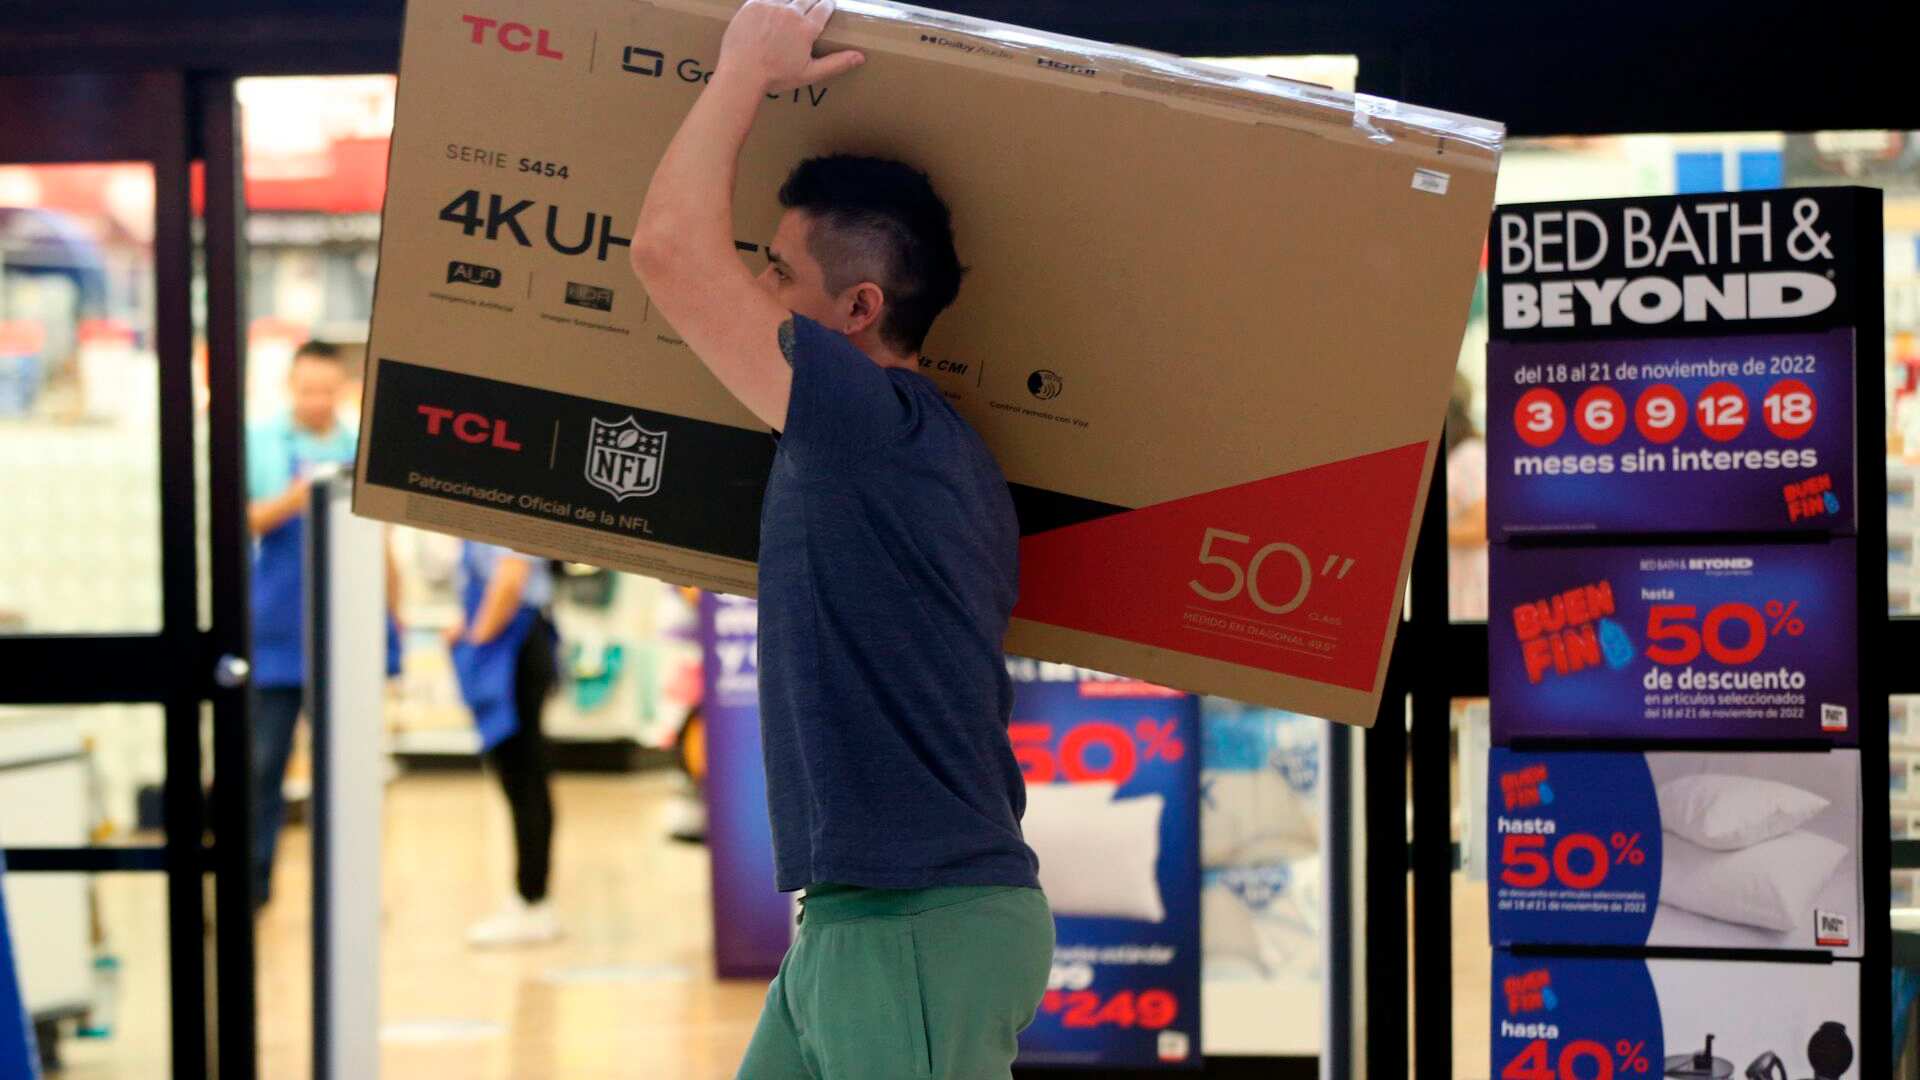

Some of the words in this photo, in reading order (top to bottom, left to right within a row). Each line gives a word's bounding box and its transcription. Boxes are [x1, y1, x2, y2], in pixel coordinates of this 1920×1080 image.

[462, 15, 564, 61] TCL
[446, 144, 508, 170] SERIE
[518, 158, 569, 180] S454
[438, 189, 535, 248] 4K
[545, 204, 631, 261] UH
[1500, 211, 1609, 274] BED
[1624, 201, 1772, 269] BATH
[1786, 198, 1835, 261] &
[1502, 271, 1838, 330] BEYOND
[1514, 365, 1541, 384] del
[1546, 365, 1567, 383] 18
[1571, 363, 1586, 382] al
[1590, 363, 1611, 381] 21
[1616, 361, 1638, 380] de
[1642, 357, 1739, 379] noviembre
[1743, 357, 1766, 376] de
[1770, 356, 1816, 375] 2022
[990, 400, 1021, 413] Control
[1527, 401, 1554, 432] 3
[1584, 399, 1614, 431] 6
[1645, 397, 1675, 428] 9
[1698, 395, 1744, 426] 12
[1763, 393, 1813, 425] 18
[417, 405, 521, 452] TCL
[595, 449, 654, 488] NFL
[1514, 452, 1615, 476] meses
[1621, 447, 1665, 474] sin
[1673, 446, 1818, 472] intereses
[408, 471, 516, 505] Patrocinador
[518, 494, 571, 517] Oficial
[575, 505, 597, 522] de
[600, 510, 615, 527] la
[619, 514, 653, 534] NFL
[1689, 557, 1754, 570] BEYOND
[1513, 579, 1615, 641] BUEN
[1641, 587, 1675, 600] hasta
[1645, 599, 1805, 665] 50%
[1523, 624, 1600, 685] FIN
[1643, 667, 1673, 690] de
[1678, 667, 1806, 690] descuento
[1644, 694, 1660, 706] en
[1717, 692, 1805, 706] seleccionados
[1699, 707, 1711, 719] de
[1712, 707, 1765, 719] noviembre
[1766, 707, 1777, 719] de
[1779, 707, 1804, 719] 2022
[1497, 815, 1556, 834] hasta
[1501, 832, 1645, 889] 50%
[1501, 1019, 1559, 1039] hasta
[1501, 1038, 1649, 1080] 40%
